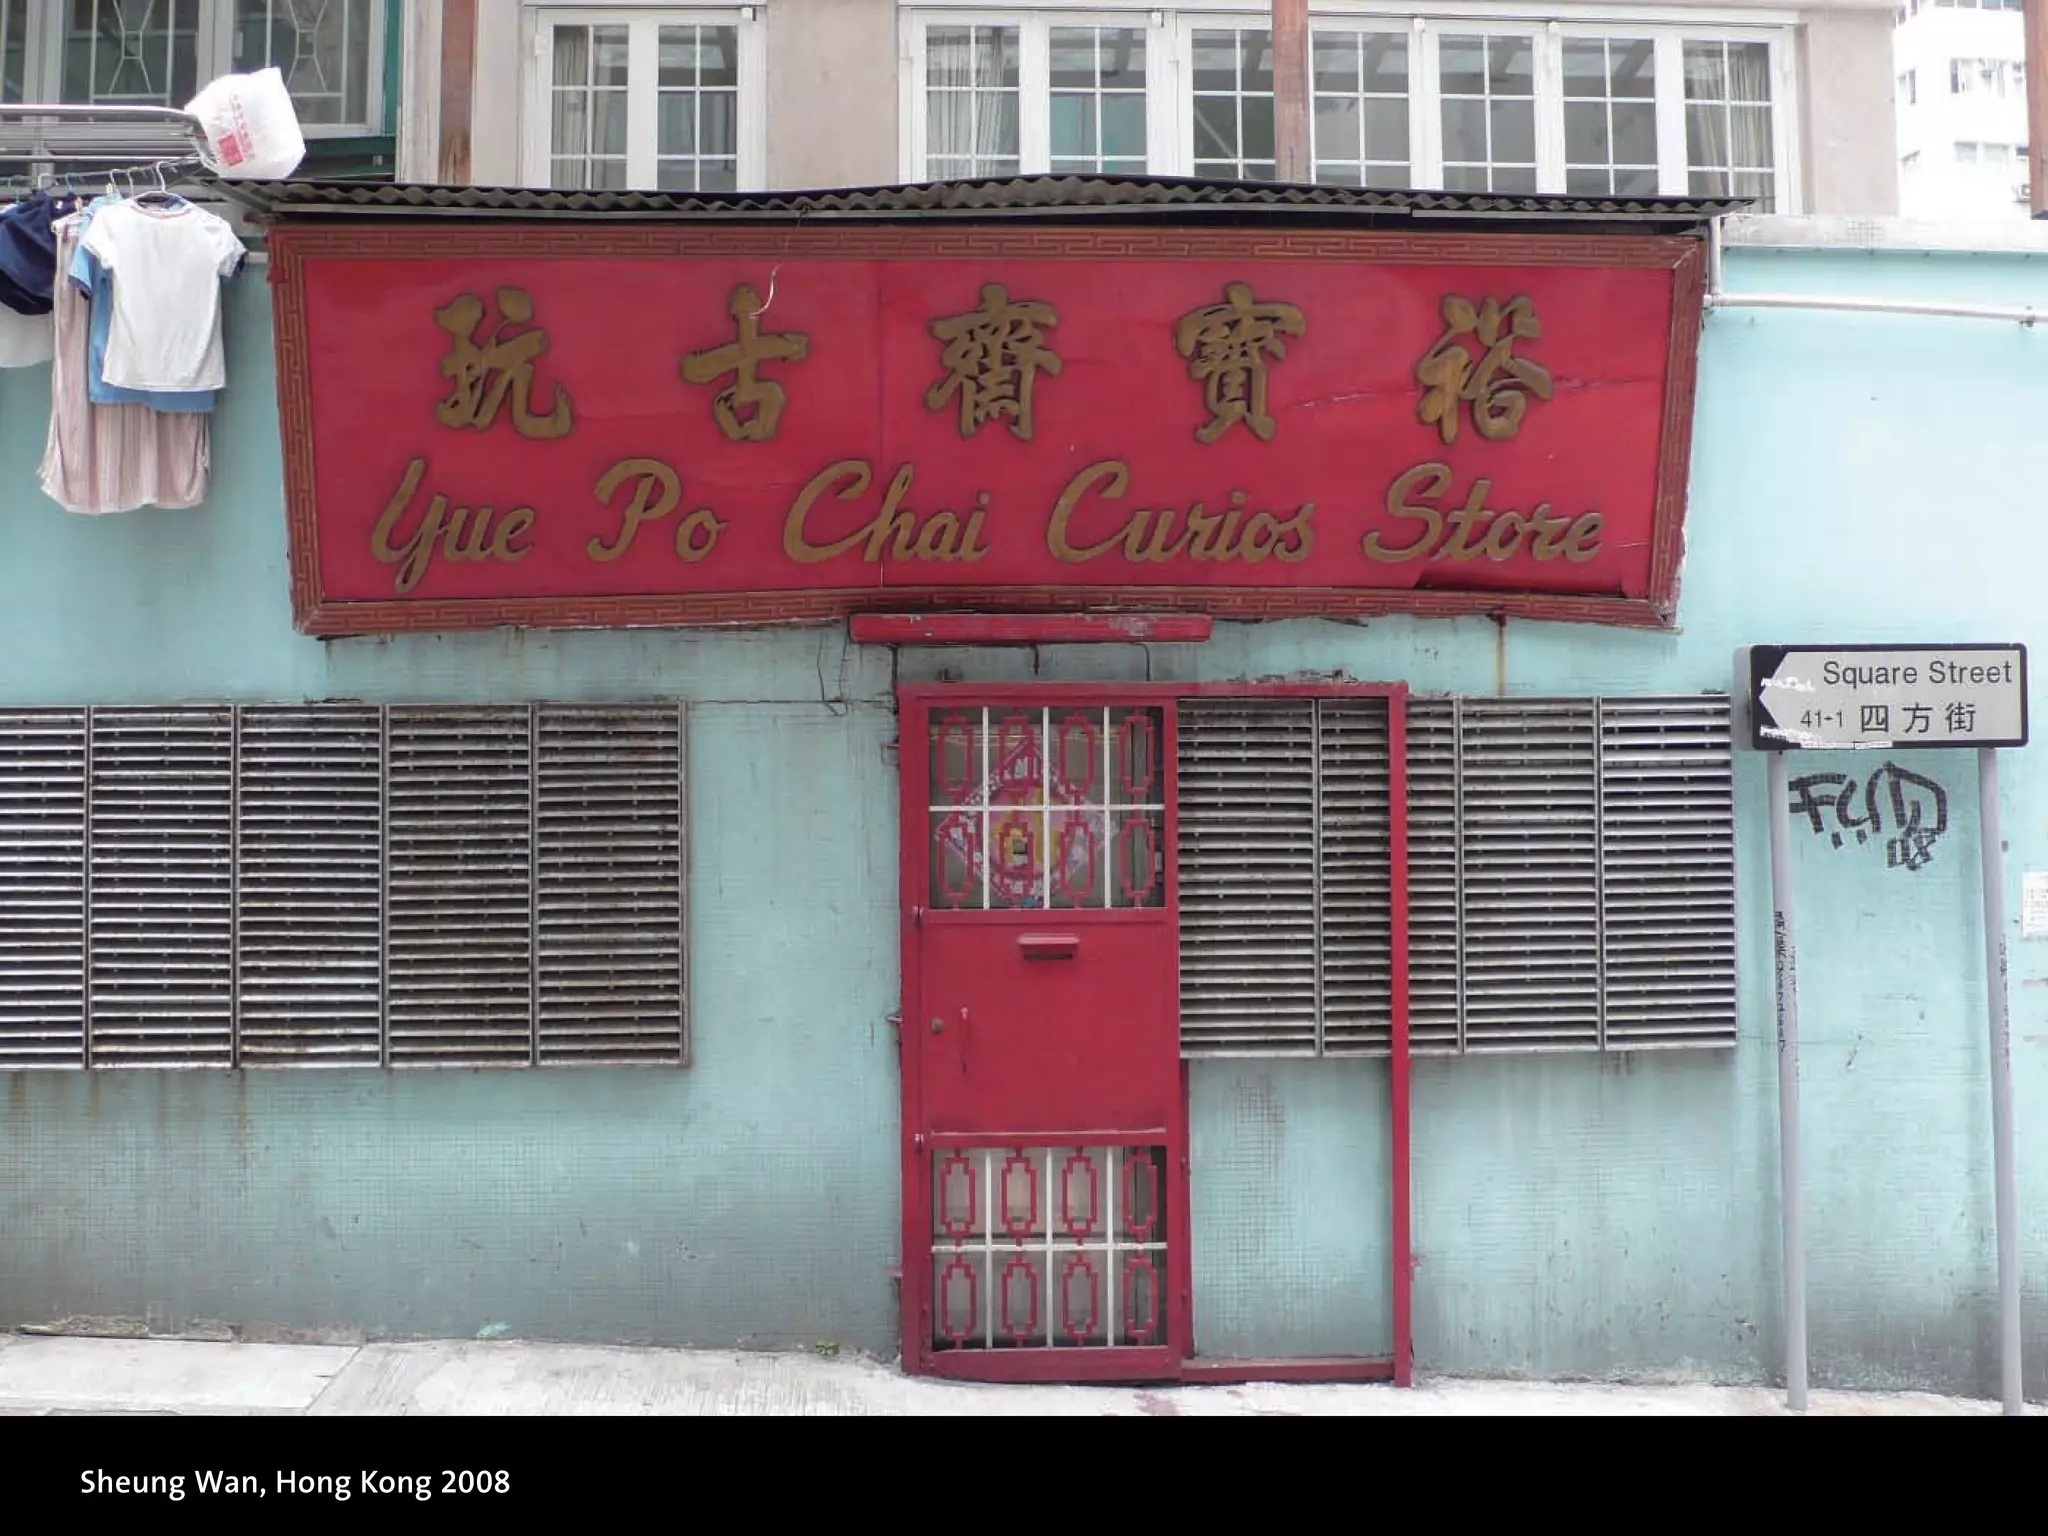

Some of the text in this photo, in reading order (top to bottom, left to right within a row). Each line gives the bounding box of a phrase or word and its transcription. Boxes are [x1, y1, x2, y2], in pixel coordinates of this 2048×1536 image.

[371, 457, 1602, 595] Yue Po Chai Curios Store
[1823, 660, 1918, 690] Square
[1929, 660, 2013, 684] Street
[1800, 710, 1844, 728] 41-1
[1860, 702, 1976, 734] 四方街
